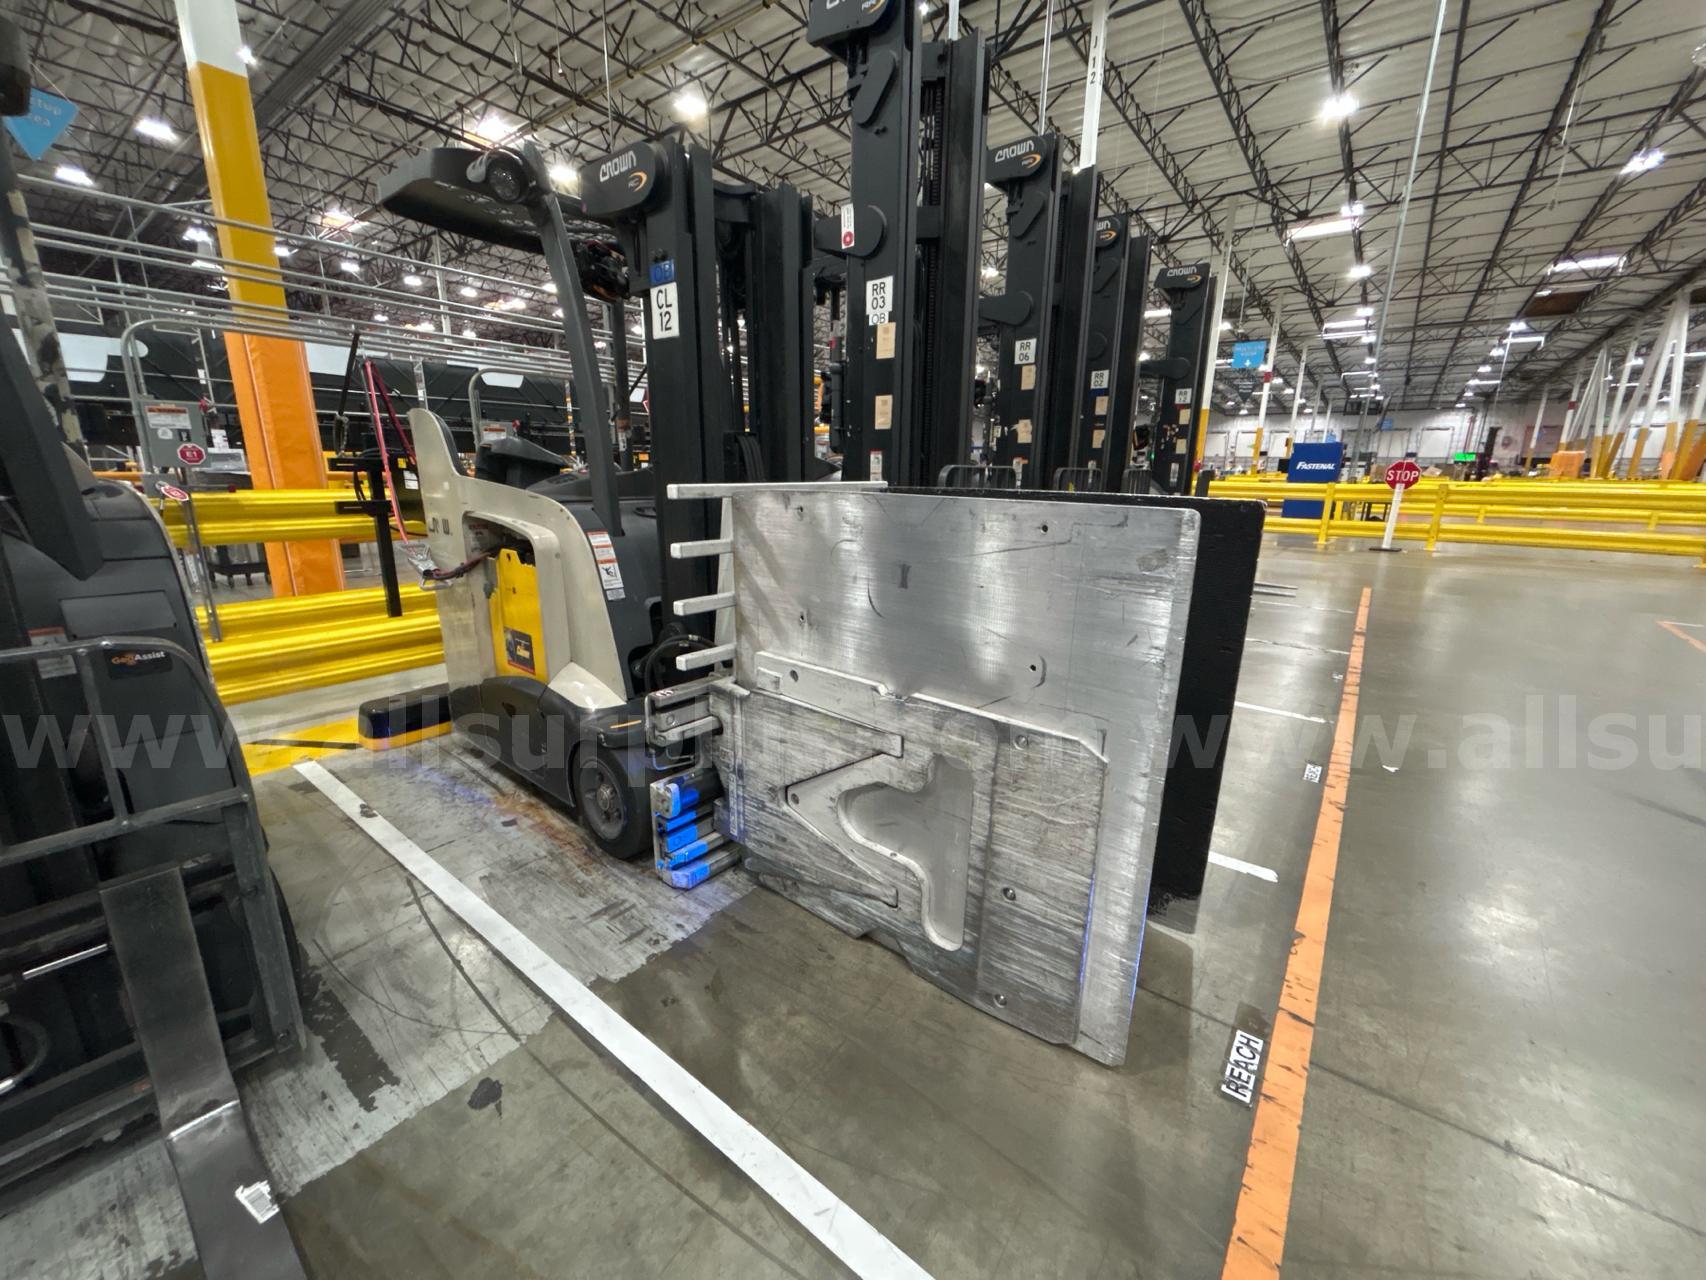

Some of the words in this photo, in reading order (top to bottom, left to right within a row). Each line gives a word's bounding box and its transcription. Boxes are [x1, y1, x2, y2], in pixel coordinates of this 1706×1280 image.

[994, 140, 1035, 163] CROWN
[599, 150, 637, 182] CROWN
[1167, 266, 1198, 277] CROWN
[871, 282, 886, 296] RR
[656, 287, 672, 310] CL
[871, 296, 886, 310] 03
[659, 311, 672, 332] 12
[871, 313, 886, 325] OB
[1019, 341, 1031, 351] RR
[1018, 352, 1030, 361] 06
[1296, 461, 1336, 470] FASTENAL
[1386, 470, 1419, 482] STOP
[1224, 1034, 1260, 1098] REACH
